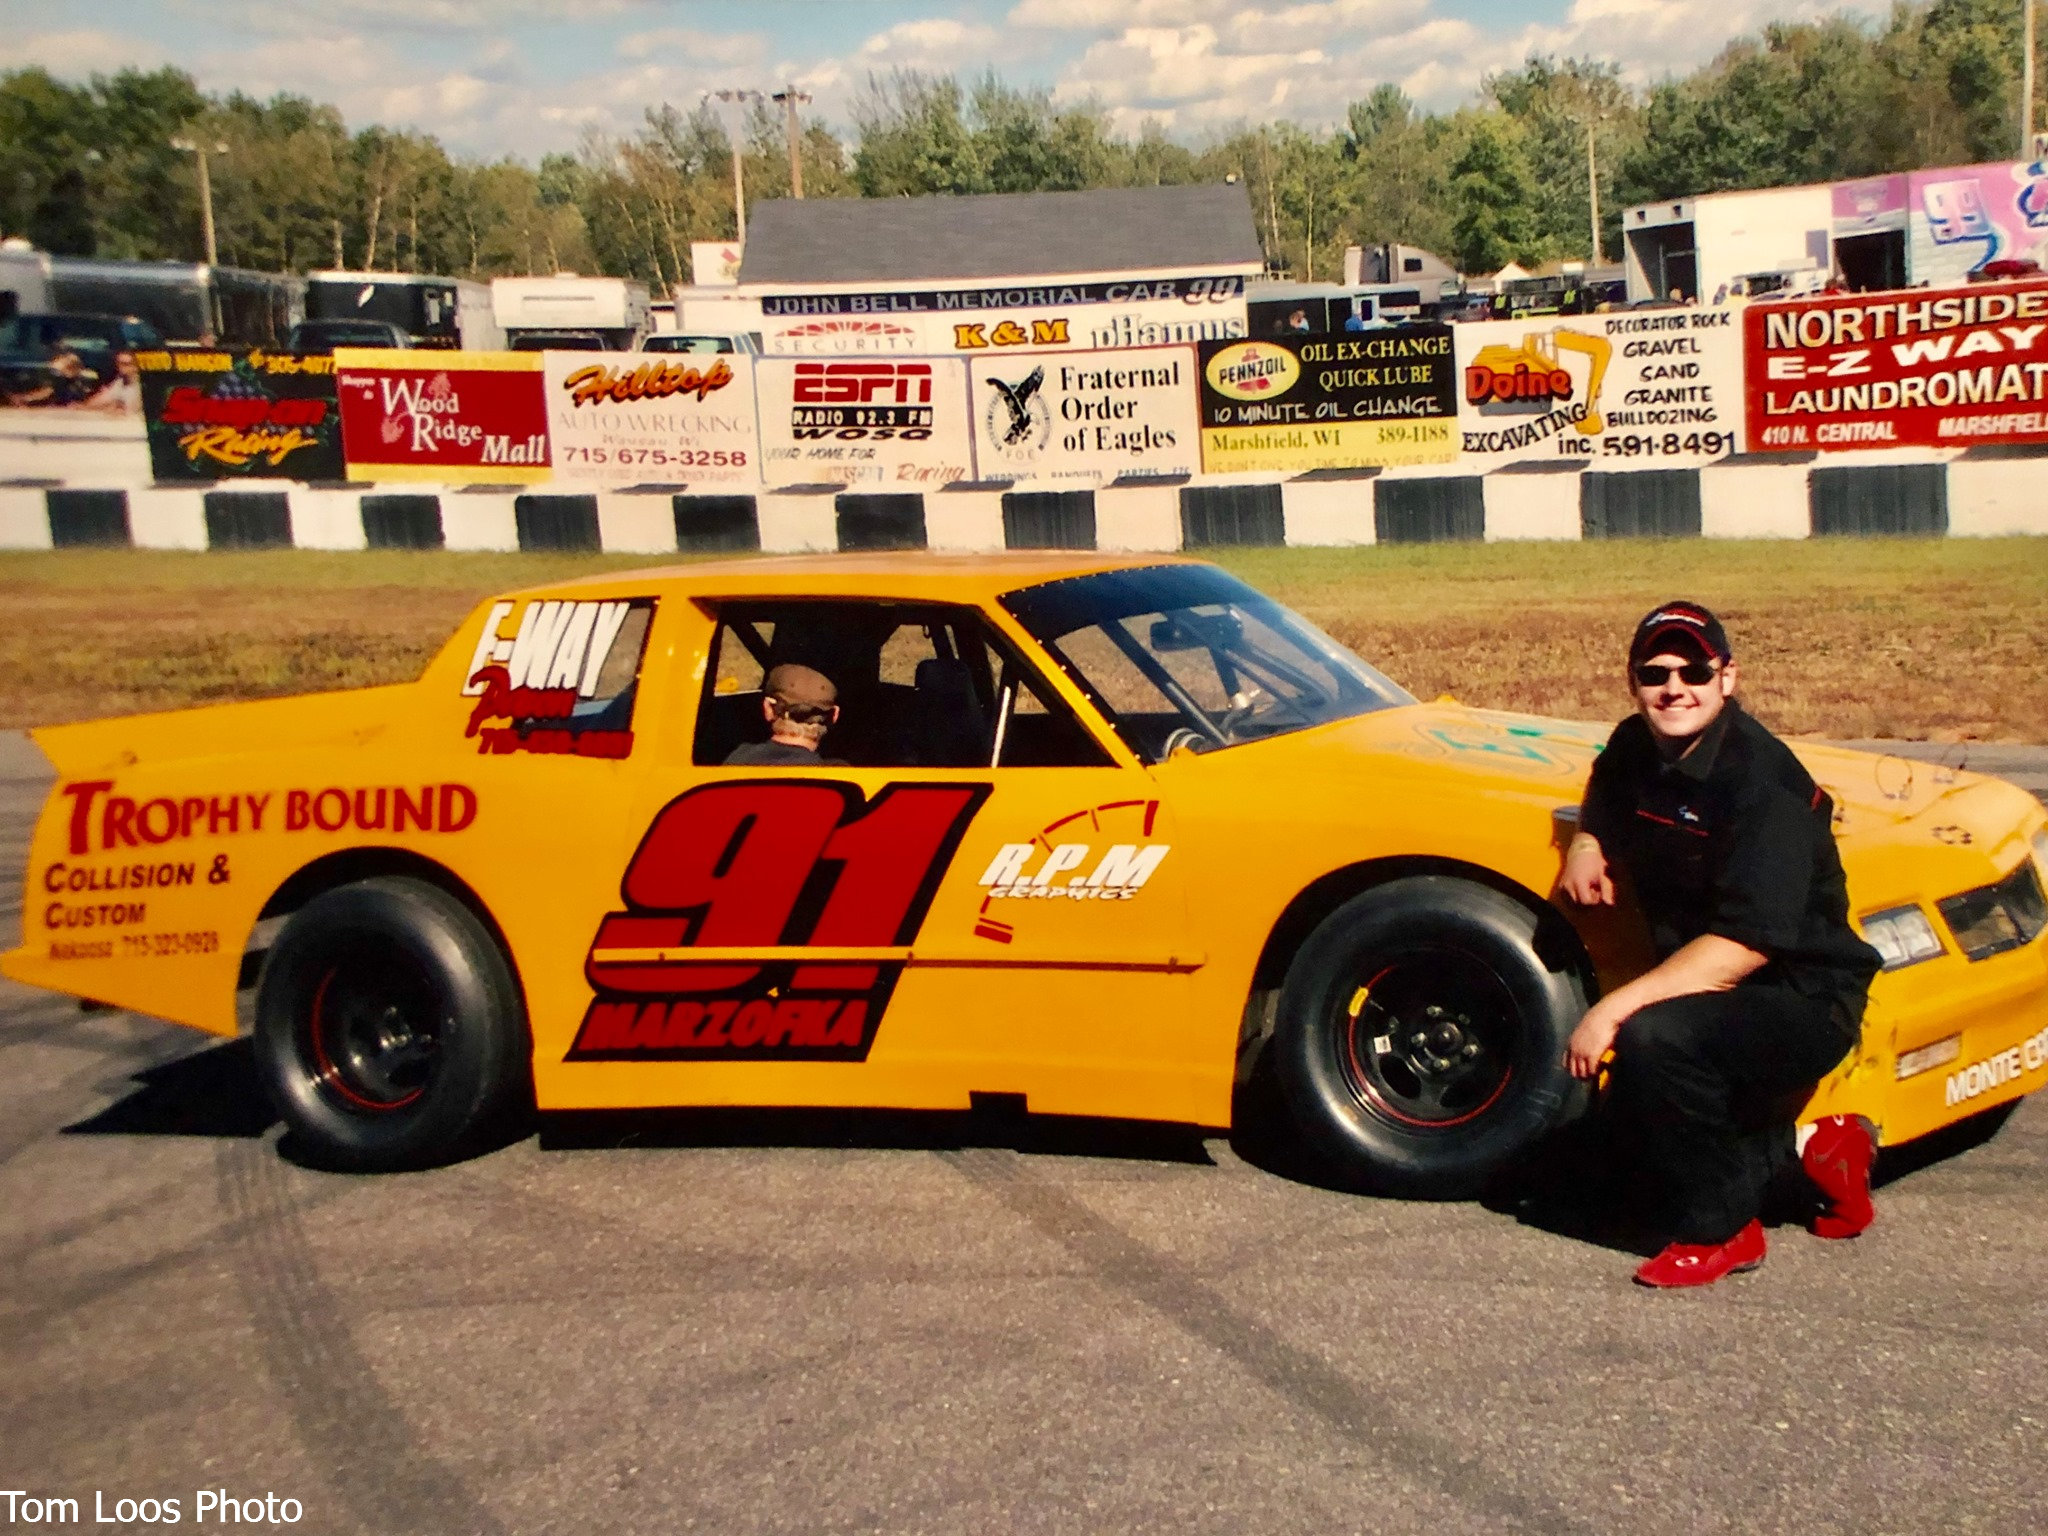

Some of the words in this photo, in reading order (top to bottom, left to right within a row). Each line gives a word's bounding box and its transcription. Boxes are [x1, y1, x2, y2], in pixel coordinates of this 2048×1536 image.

[767, 297, 840, 314] JOHN
[850, 295, 927, 312] BELL
[937, 285, 1096, 311] MEMORIAL
[1105, 282, 1176, 301] CAR
[954, 323, 989, 350] K
[991, 321, 1029, 345] &
[1032, 318, 1070, 345] M
[1606, 314, 1687, 335] DECORATOR
[1692, 312, 1731, 328] ROCK
[1766, 290, 2048, 349] NORTHSIDE
[774, 337, 917, 353] SECURITY
[1300, 343, 1334, 362] OIL
[1337, 336, 1450, 361] EX-CHANGE
[1623, 337, 1702, 358] GRAVEL
[1767, 350, 1871, 380] E-Z
[1891, 324, 2047, 367] WAY
[564, 357, 734, 408] Hilltop
[793, 363, 932, 402] ESPN
[1060, 361, 1179, 391] Fraternal
[1218, 355, 1287, 385] PENNZOIL
[1319, 367, 1383, 392] QUICK
[1384, 365, 1432, 385] LUBE
[1465, 363, 1574, 406] Doine
[1640, 362, 1700, 383] SAND
[380, 377, 460, 417] Wood
[1624, 385, 1712, 405] GRANITE
[1766, 362, 2048, 415] LAUNDROMAT
[559, 411, 621, 430] AUTO
[627, 413, 750, 433] WRECKING
[792, 411, 844, 426] RADIO
[908, 410, 932, 425] FM
[1061, 395, 1138, 422] Order
[1214, 406, 1232, 424] 10
[1238, 402, 1311, 425] MINUTE
[1315, 402, 1348, 419] OIL
[1353, 395, 1443, 417] CHANGE
[1606, 407, 1718, 428] BULLDOZING
[411, 413, 483, 452] Ridge
[1063, 426, 1088, 451] of
[1096, 424, 1177, 457] Eagles
[1313, 430, 1341, 446] WI
[1376, 425, 1449, 444] 389-1188
[1461, 402, 1588, 453] EXCAVATING
[1761, 426, 1790, 446] 410
[1793, 426, 1809, 444] N.
[1816, 421, 1898, 443] CENTRAL
[1937, 411, 2048, 438] MARSHFIEL
[481, 433, 546, 464] Mall
[1558, 433, 1597, 455] inc.
[62, 780, 270, 855] TROPHY
[285, 783, 478, 833] BOUND
[44, 861, 196, 894] COLLISION
[208, 853, 231, 885] &
[978, 843, 1171, 888] R.P.M
[588, 780, 990, 994] 91
[988, 886, 1138, 901] GRAPHICS
[44, 901, 146, 930] CUSTOM
[577, 998, 870, 1050] MARZOFKA
[1945, 1046, 2023, 1107] MONTE
[2023, 1024, 2048, 1071] CA
